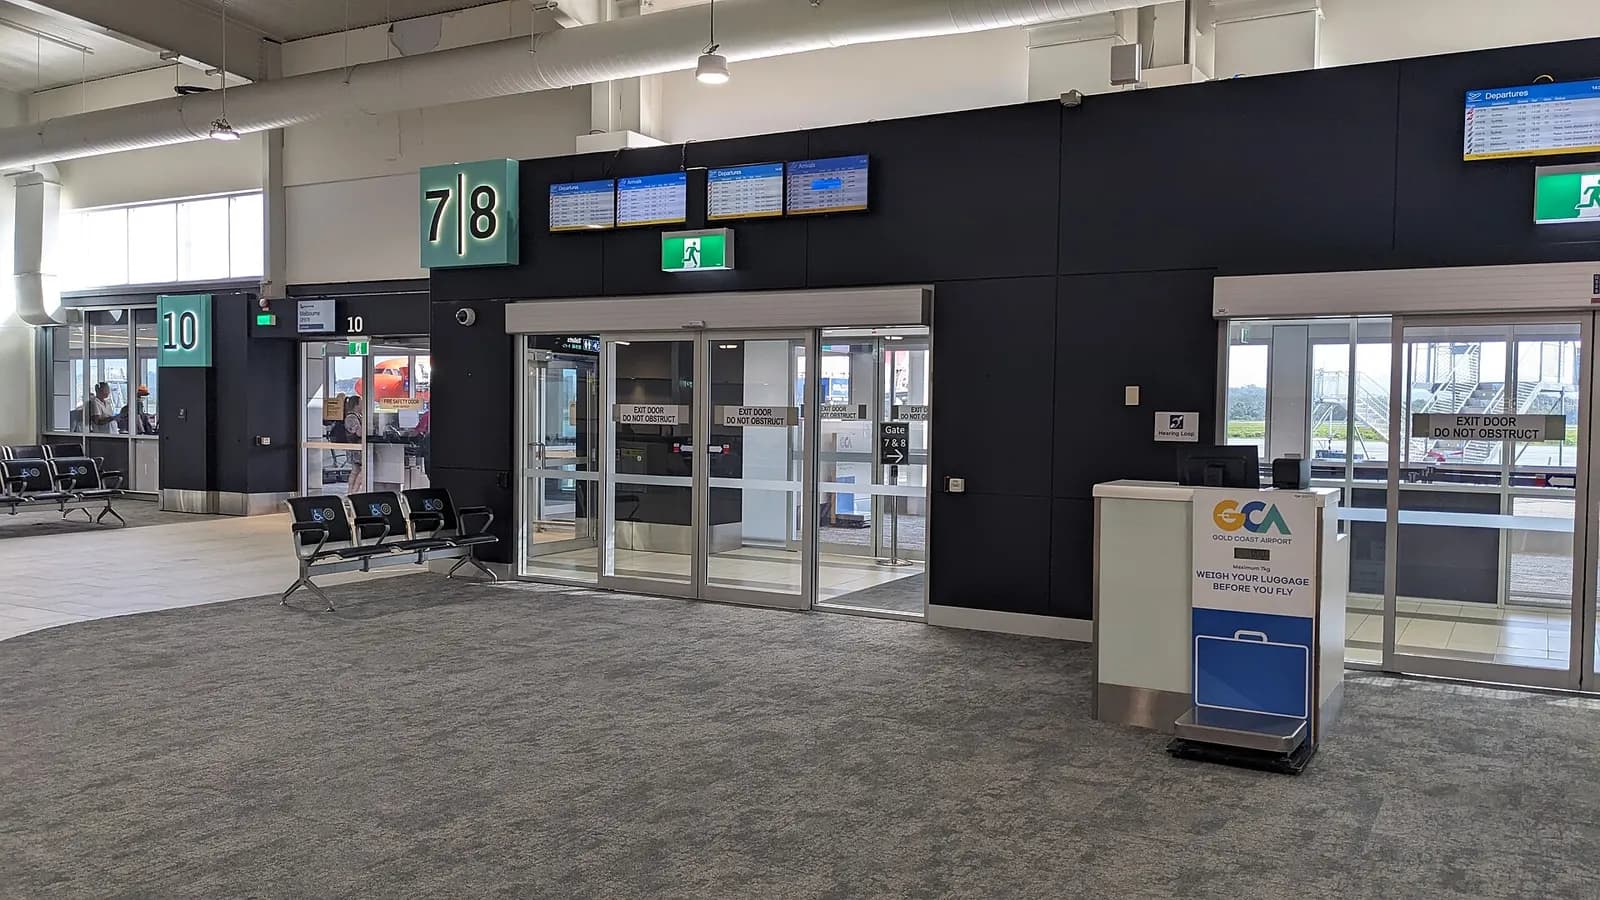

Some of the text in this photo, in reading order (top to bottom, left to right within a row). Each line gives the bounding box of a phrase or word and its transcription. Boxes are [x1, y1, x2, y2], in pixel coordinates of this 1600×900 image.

[1485, 90, 1529, 100] Departures
[347, 317, 363, 333] 10
[163, 312, 198, 350] 10
[739, 408, 772, 416] EXIT DOOR
[645, 415, 676, 423] OBSTRUCT
[737, 417, 750, 425] NOT
[751, 417, 784, 426] OBSTRUCT
[1456, 416, 1516, 427] EXIT DOOR
[885, 426, 905, 434] Gate
[1434, 428, 1539, 440] DO NOT OBSTRUCT
[884, 439, 906, 447] 7 & 8
[1213, 499, 1292, 535] GCA
[1234, 535, 1259, 543] COAST
[1260, 537, 1292, 545] AIRPORT
[1196, 570, 1309, 586] WEIGH YOUR LUGGAGE
[1213, 583, 1294, 596] BEFORE YOU FLY
